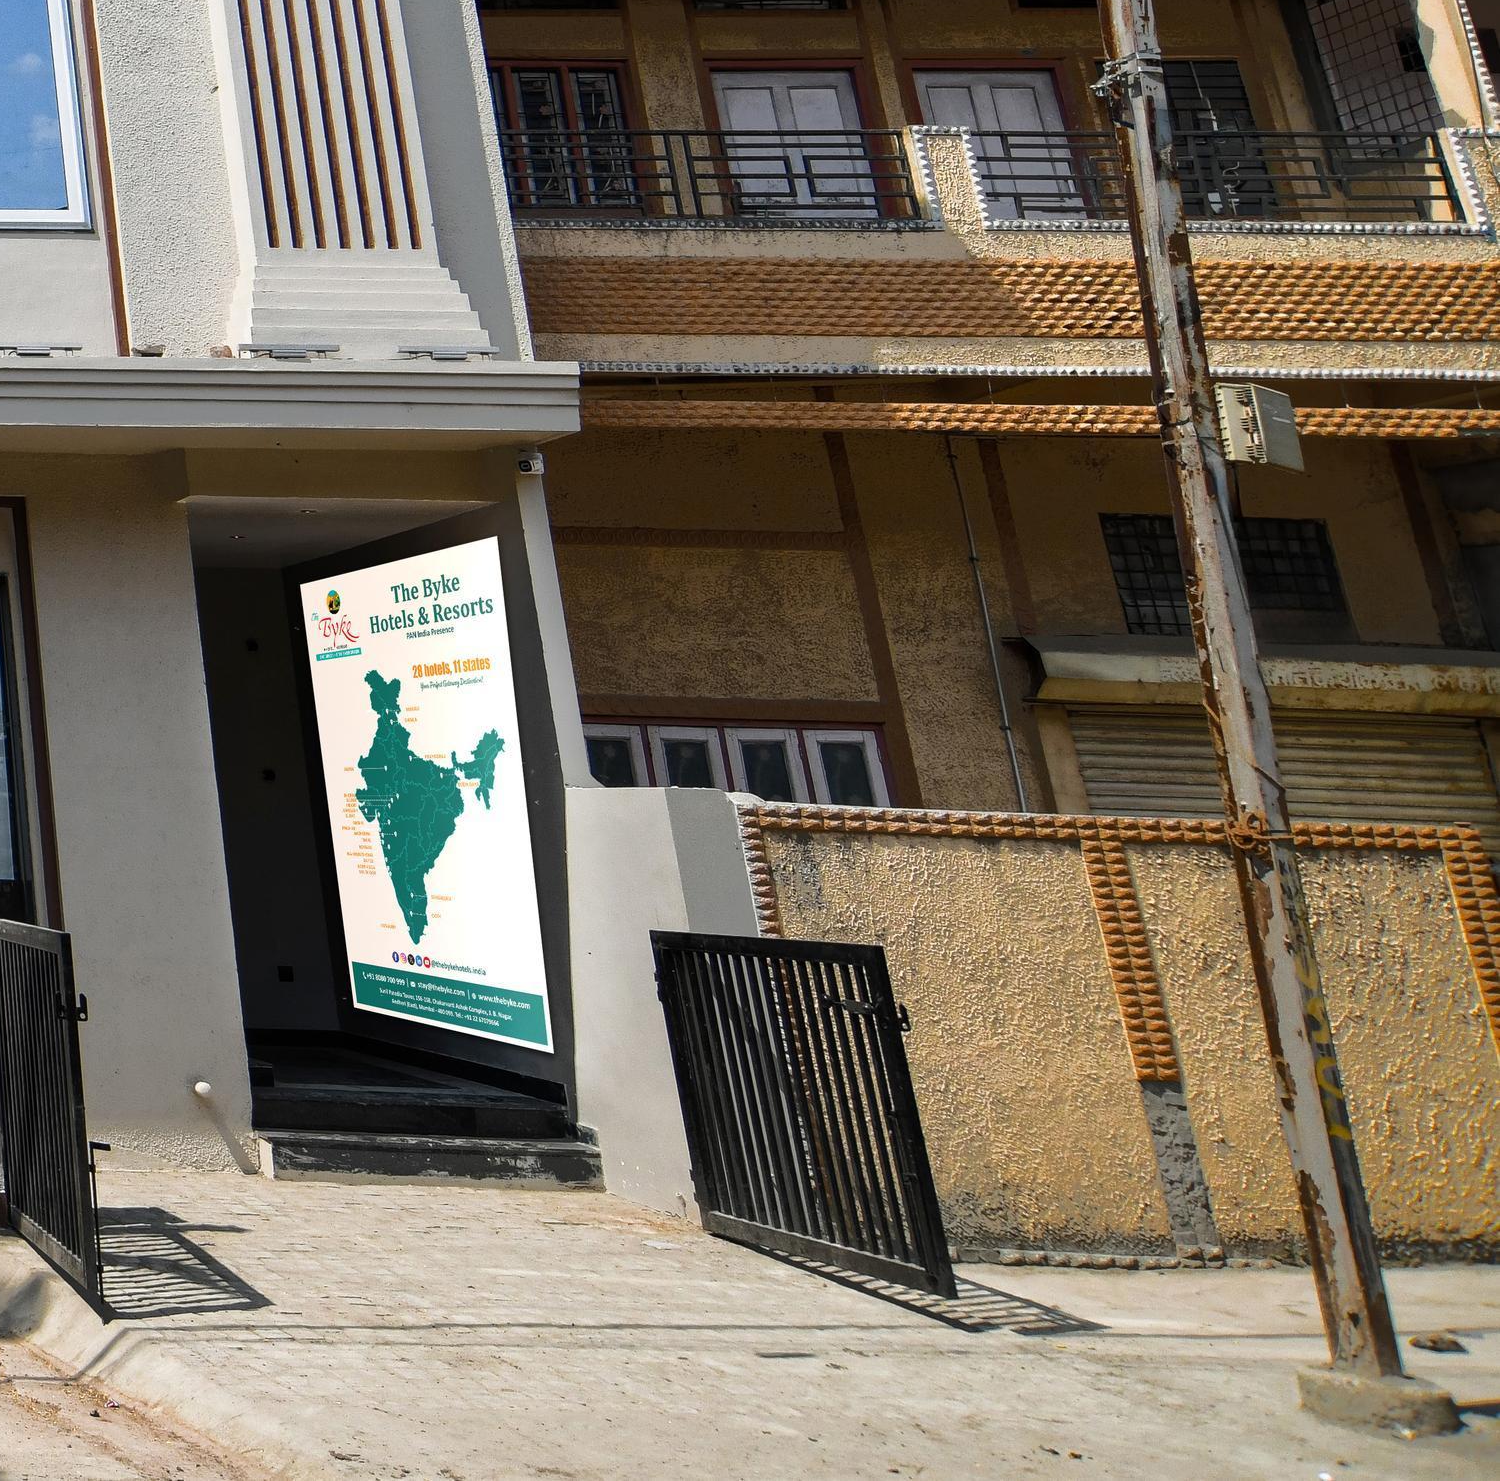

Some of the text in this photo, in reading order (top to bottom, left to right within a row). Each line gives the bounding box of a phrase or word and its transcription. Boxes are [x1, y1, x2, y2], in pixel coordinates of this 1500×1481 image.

[391, 574, 460, 604] The Byke
[370, 598, 494, 634] Hotels & Resorts
[318, 614, 360, 648] Byke
[417, 630, 430, 638] India
[431, 626, 454, 635] Presence
[412, 657, 491, 678] 28 hotels, 11 states
[478, 994, 531, 1010] www.thebyke.com
